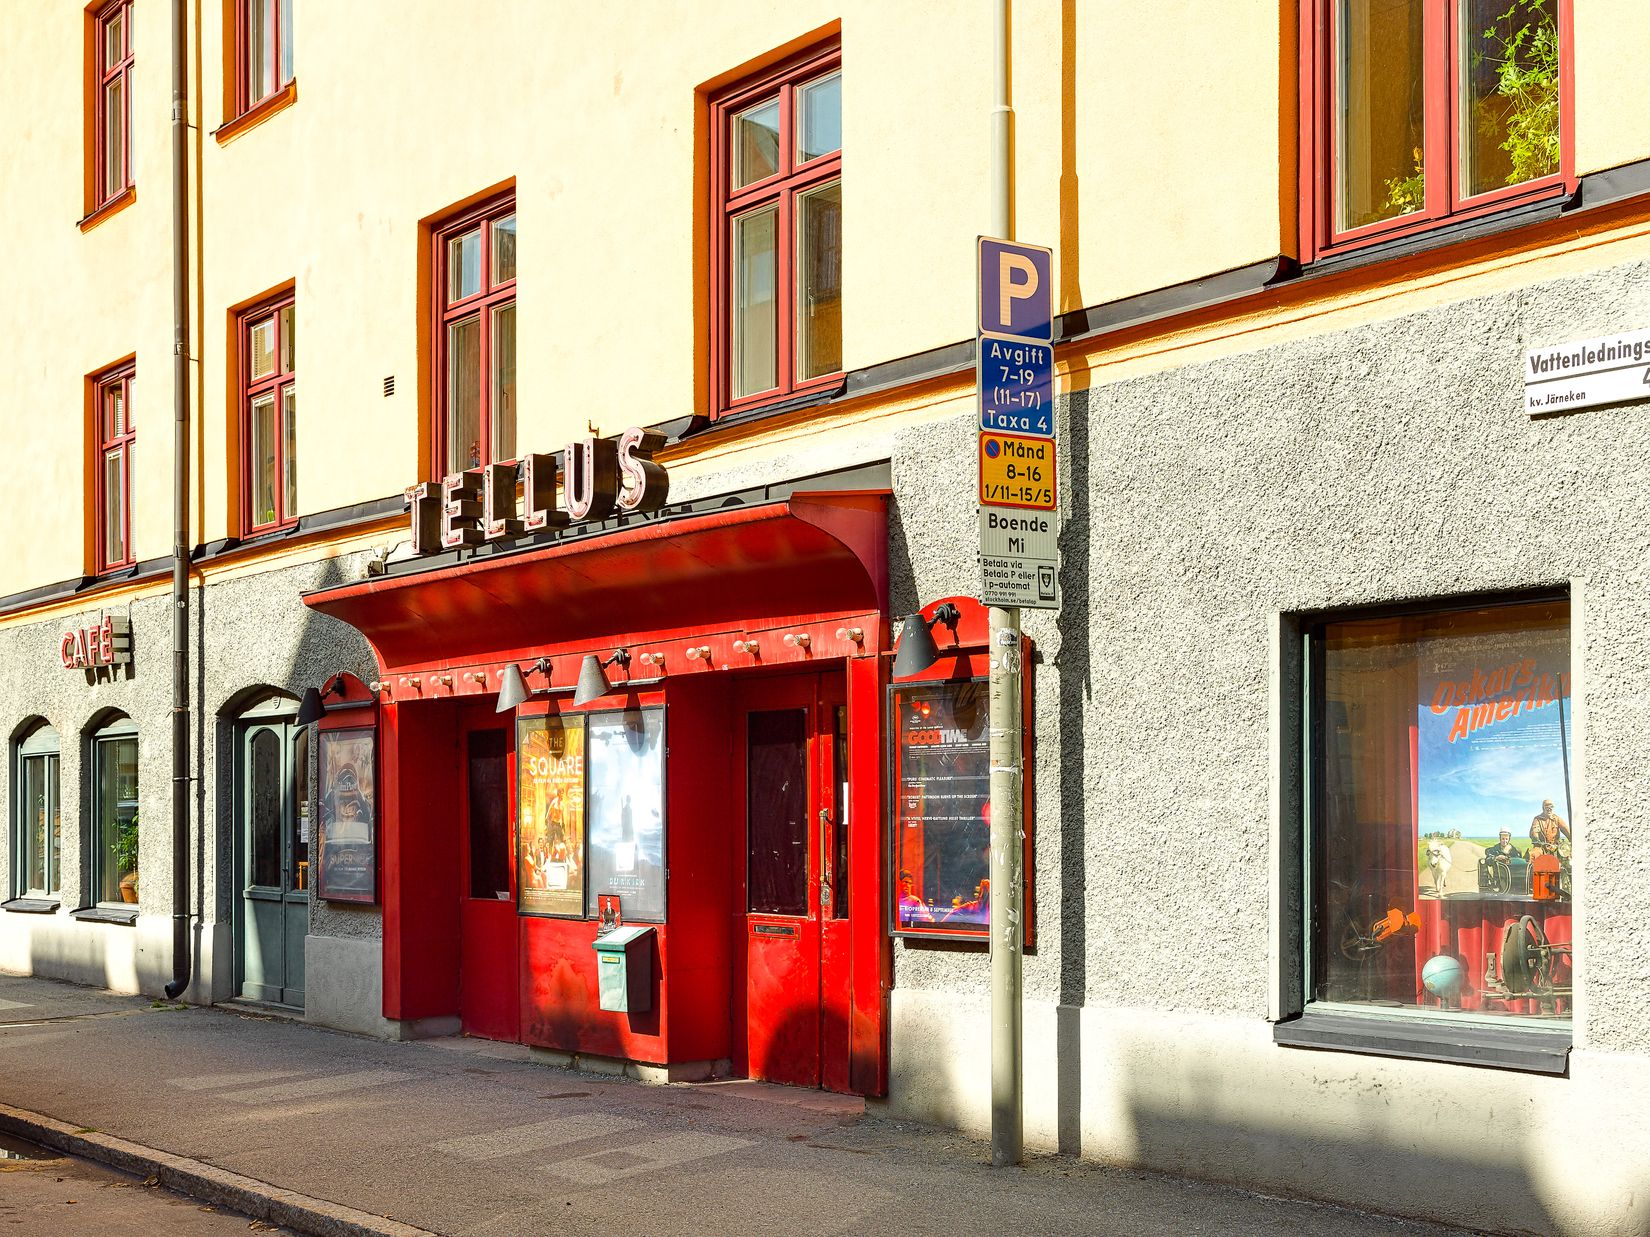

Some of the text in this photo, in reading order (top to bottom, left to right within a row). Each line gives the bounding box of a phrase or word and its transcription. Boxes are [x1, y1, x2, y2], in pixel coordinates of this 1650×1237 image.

[1000, 251, 1039, 327] P
[990, 343, 1043, 365] Avgift
[1530, 340, 1650, 374] Vattenlednings
[1000, 366, 1034, 385] 7-19
[994, 386, 1041, 410] (11-17)
[1530, 390, 1586, 408] kv. Järneken
[988, 410, 1048, 432] Taxa 4
[1003, 441, 1045, 460] Månd
[1007, 464, 1042, 482] 8-16
[404, 427, 668, 556] TELLUS
[985, 484, 1052, 503] 1/11-15/5
[989, 513, 1049, 533] Boende
[1008, 537, 1025, 553] Mi
[983, 558, 1023, 569] Betala via
[983, 569, 1036, 580] Betala P eller
[989, 581, 1031, 590] p-automat
[61, 616, 113, 669] CAFÉ
[1430, 658, 1537, 715] Oskars
[549, 737, 564, 748] THE
[530, 756, 582, 776] SQUARE
